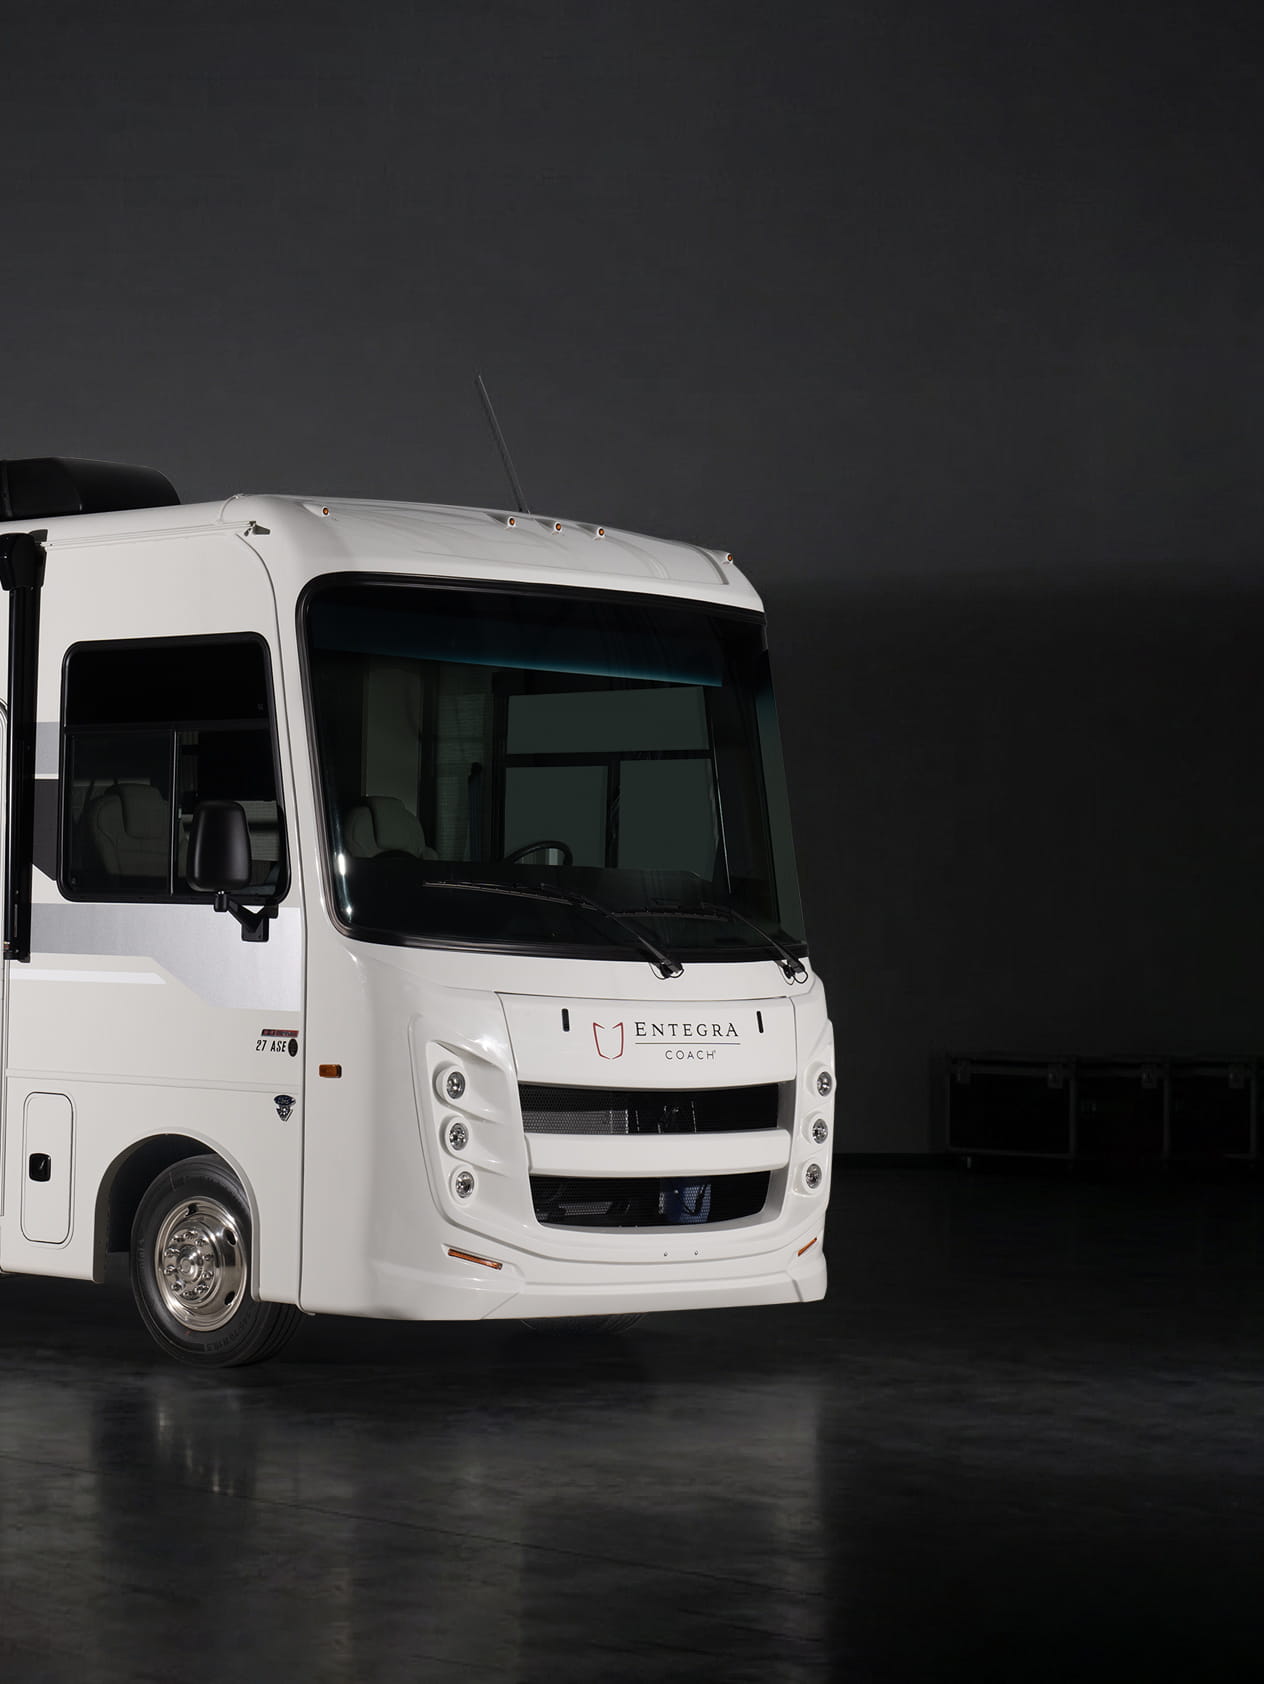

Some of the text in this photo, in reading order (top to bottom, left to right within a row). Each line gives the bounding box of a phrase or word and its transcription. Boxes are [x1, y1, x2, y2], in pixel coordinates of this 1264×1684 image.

[635, 1022, 739, 1037] ENTEGRA
[256, 1040, 287, 1052] 27 ASE
